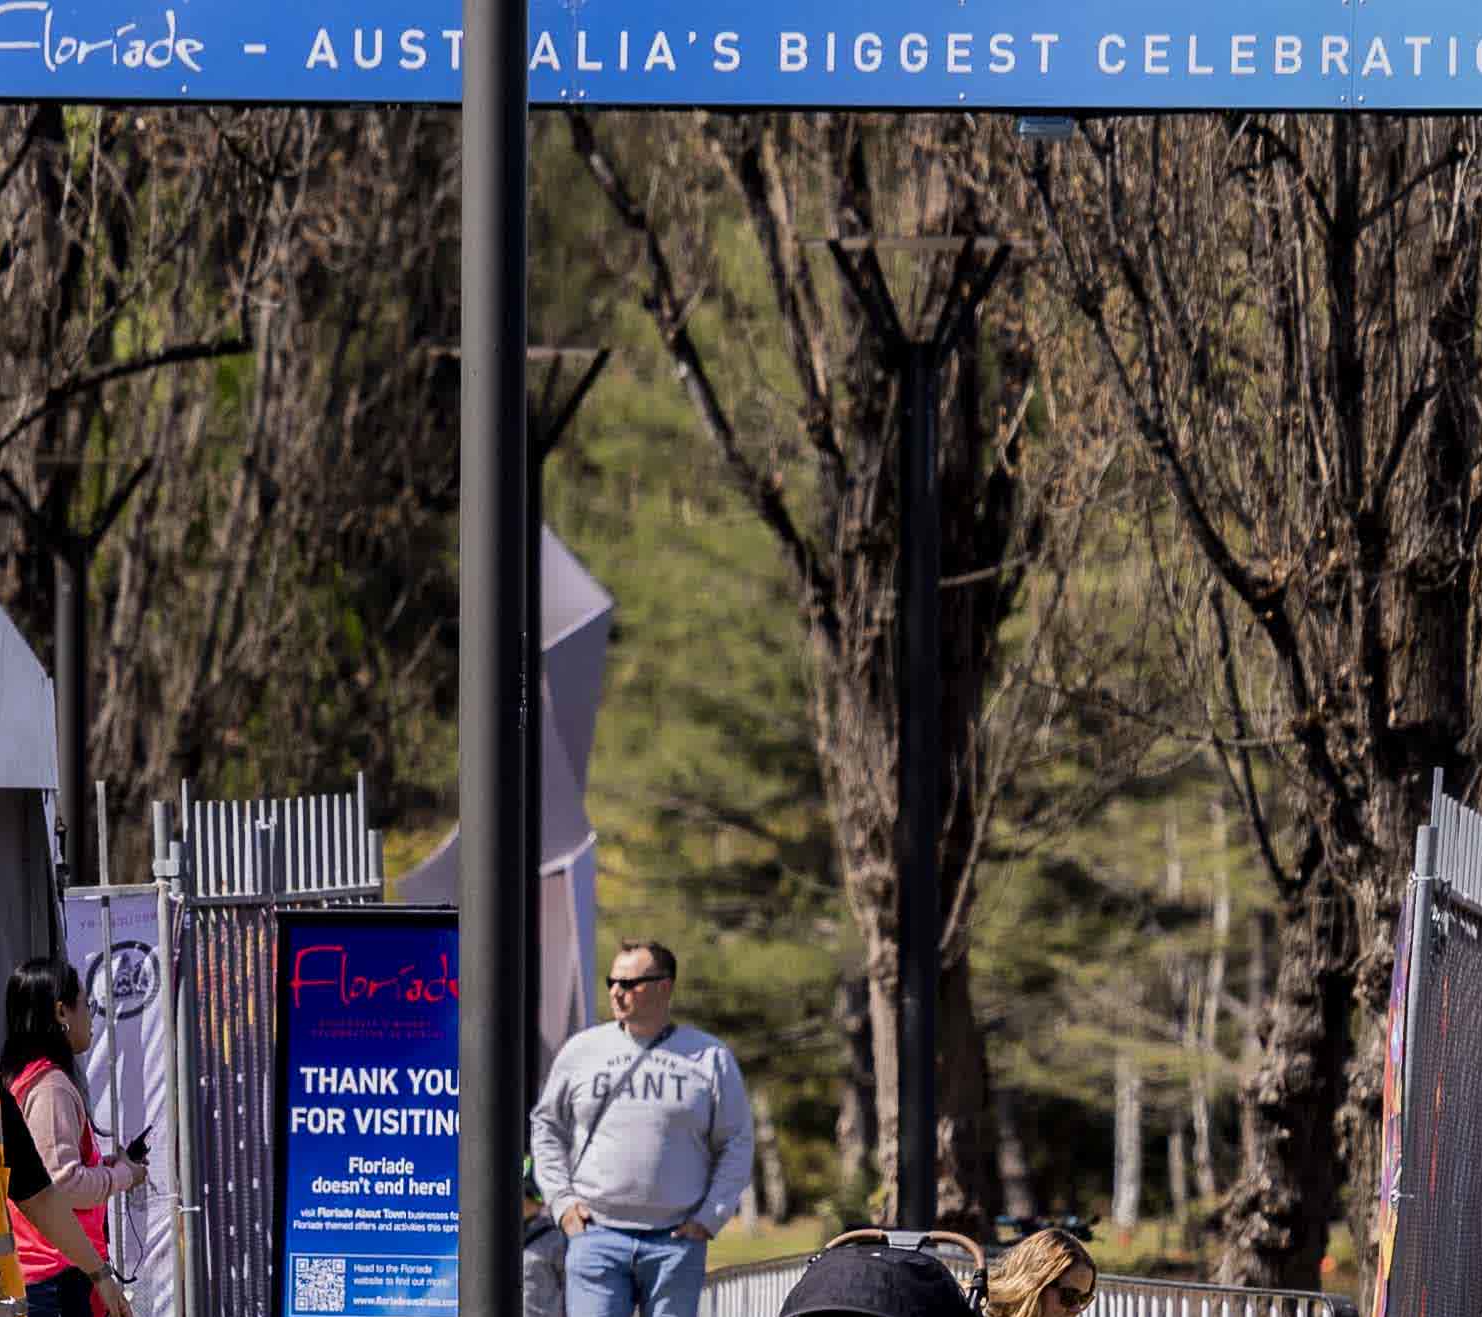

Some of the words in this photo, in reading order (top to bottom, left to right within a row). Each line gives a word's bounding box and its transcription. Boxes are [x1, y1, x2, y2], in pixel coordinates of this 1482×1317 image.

[305, 29, 741, 73] AUSTALIA'S
[779, 32, 1061, 75] BIGGEST
[299, 1066, 399, 1095] THANK
[406, 1068, 460, 1096] YOU
[592, 1072, 689, 1102] GANT
[291, 1106, 346, 1135] FOR
[352, 1107, 460, 1137] VISITIN
[348, 1157, 415, 1175] Floriade
[311, 1176, 371, 1195] doesn't
[374, 1178, 404, 1195] end
[408, 1178, 451, 1197] here!
